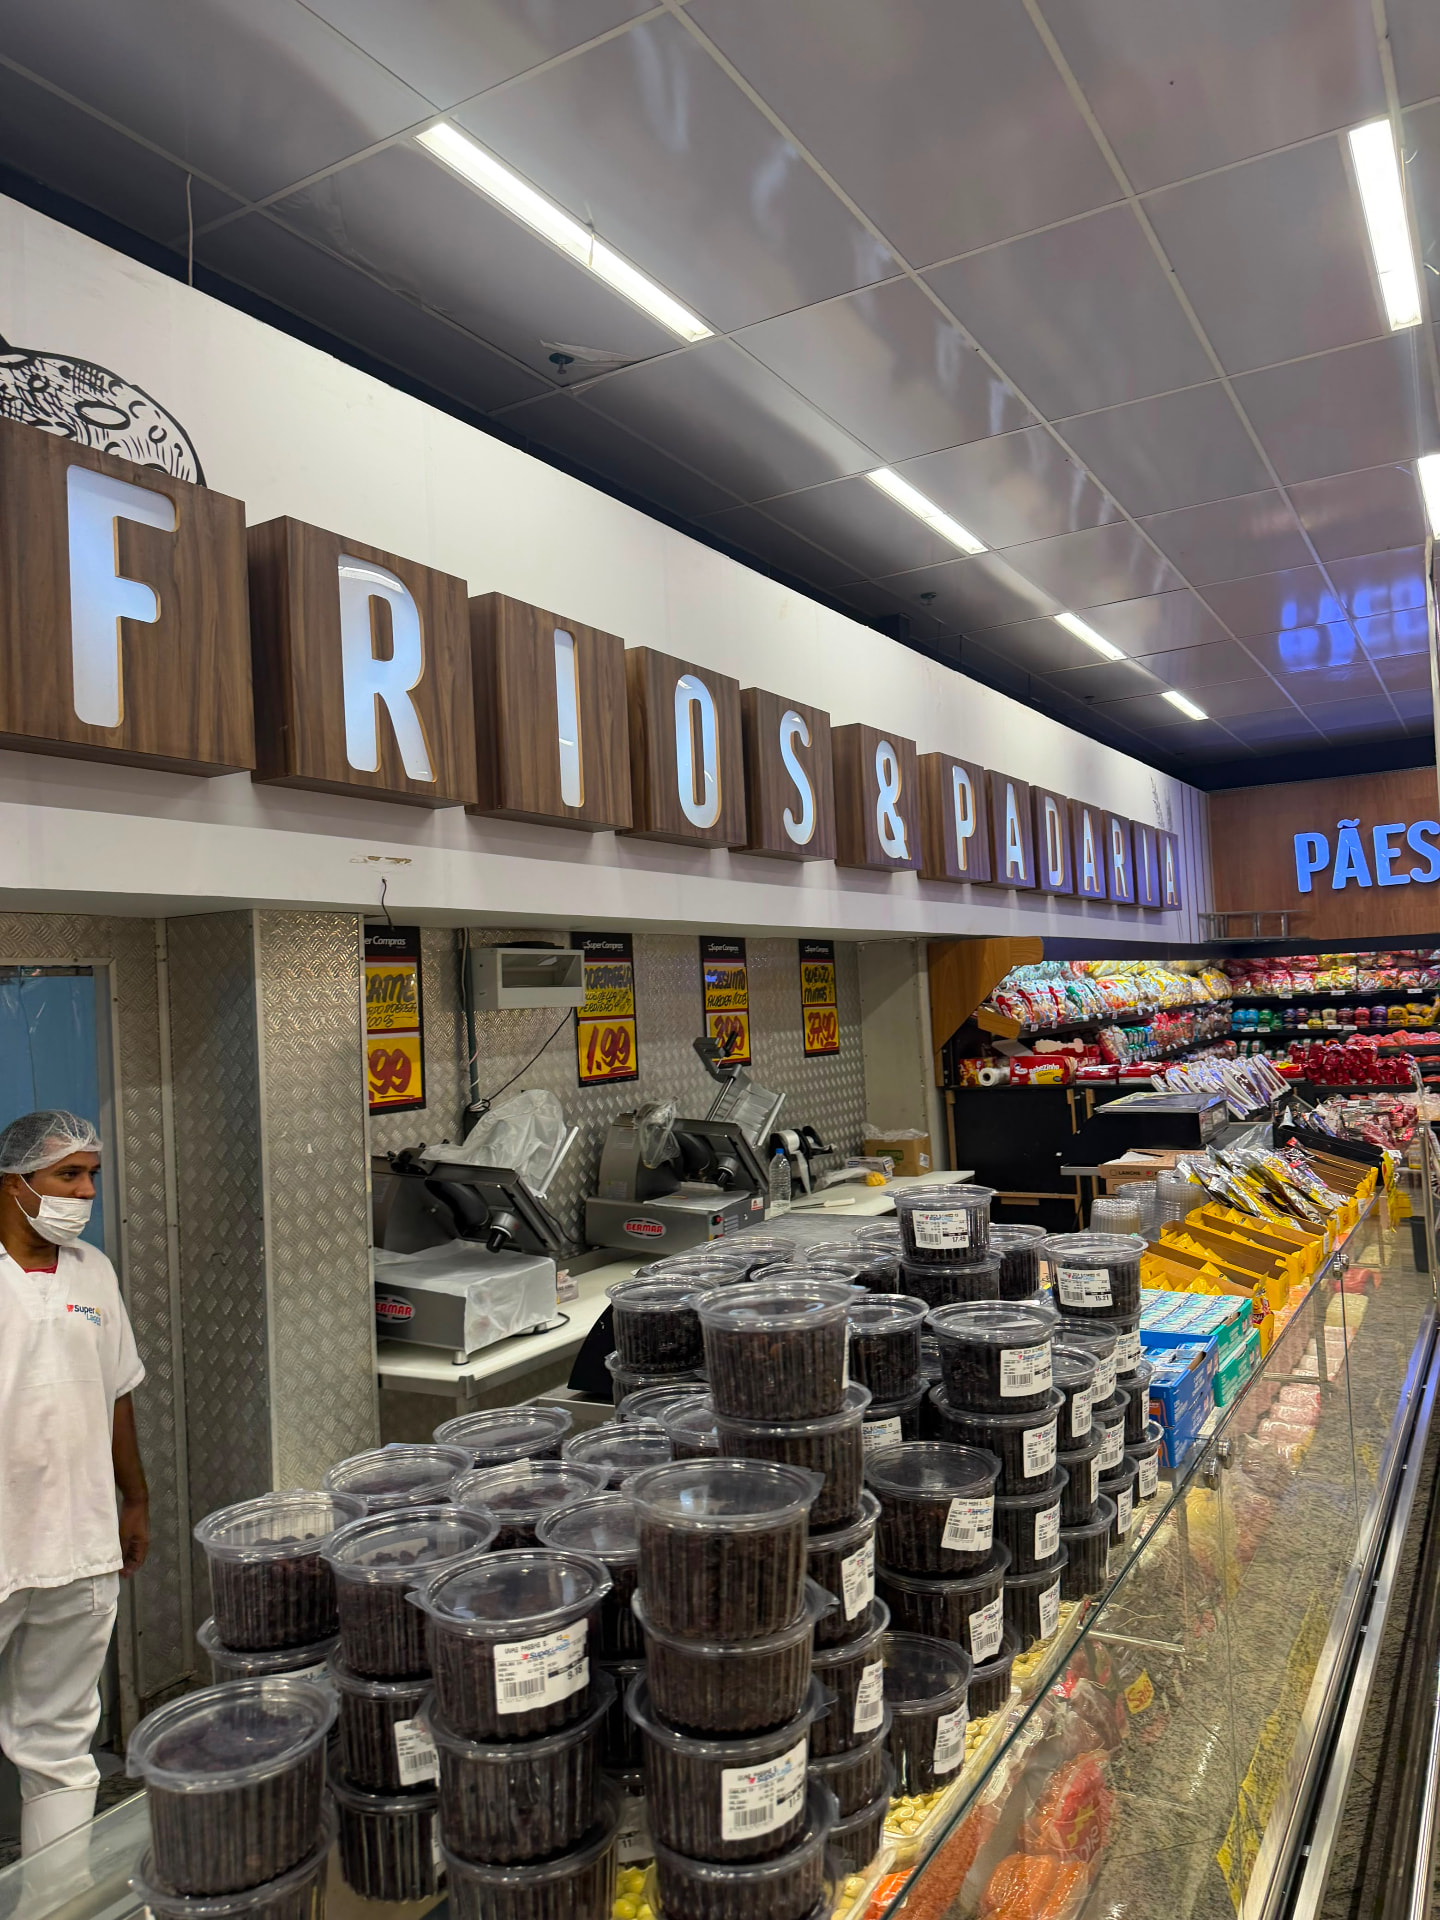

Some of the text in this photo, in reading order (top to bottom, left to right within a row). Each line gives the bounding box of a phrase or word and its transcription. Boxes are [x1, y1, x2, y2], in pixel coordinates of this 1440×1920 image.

[67, 464, 1179, 906] FRIOS & PADARIA
[1294, 818, 1440, 893] PÃES
[625, 1222, 664, 1234] BERMAR
[74, 1304, 95, 1315] Super
[376, 1301, 412, 1316] ERMAR
